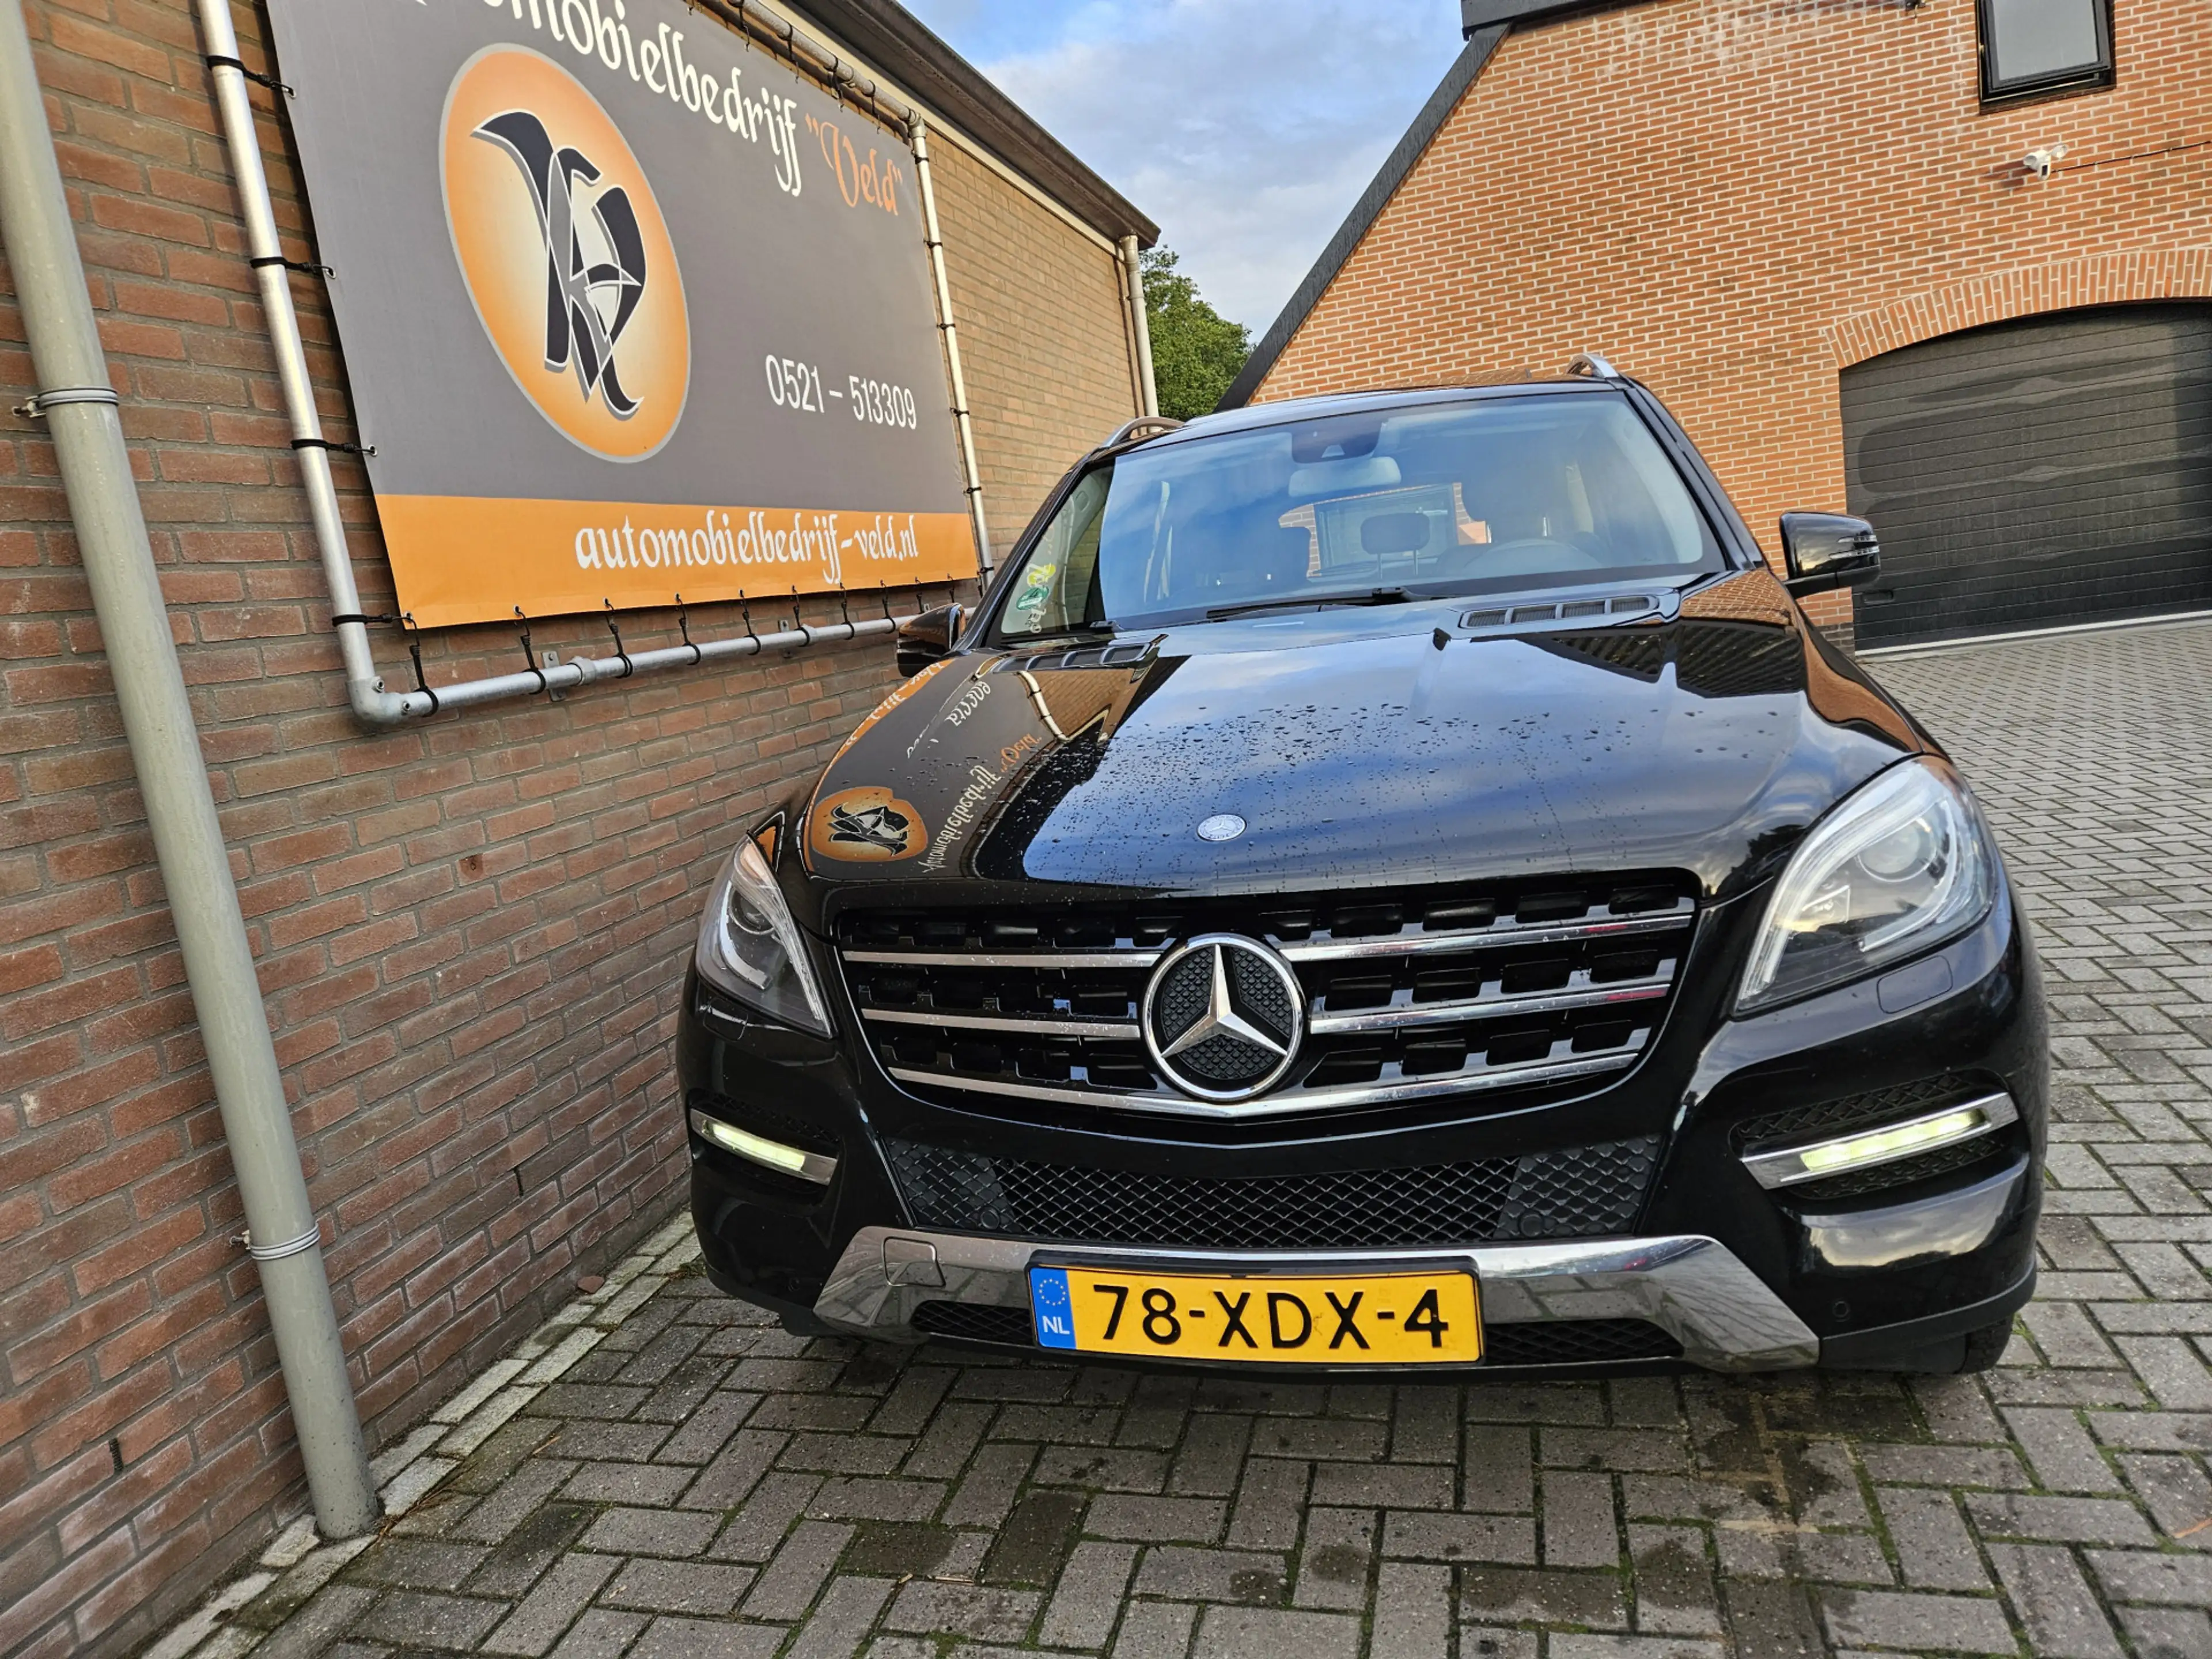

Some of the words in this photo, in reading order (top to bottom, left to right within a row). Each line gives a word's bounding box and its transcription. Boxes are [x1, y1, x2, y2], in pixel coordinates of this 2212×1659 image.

[765, 354, 825, 414] 0521
[849, 374, 917, 430] 513309
[575, 510, 919, 584] automobielbedrijf-veld.nl
[1042, 1315, 1070, 1335] NL
[1093, 1284, 1449, 1350] 78-XDX-4
